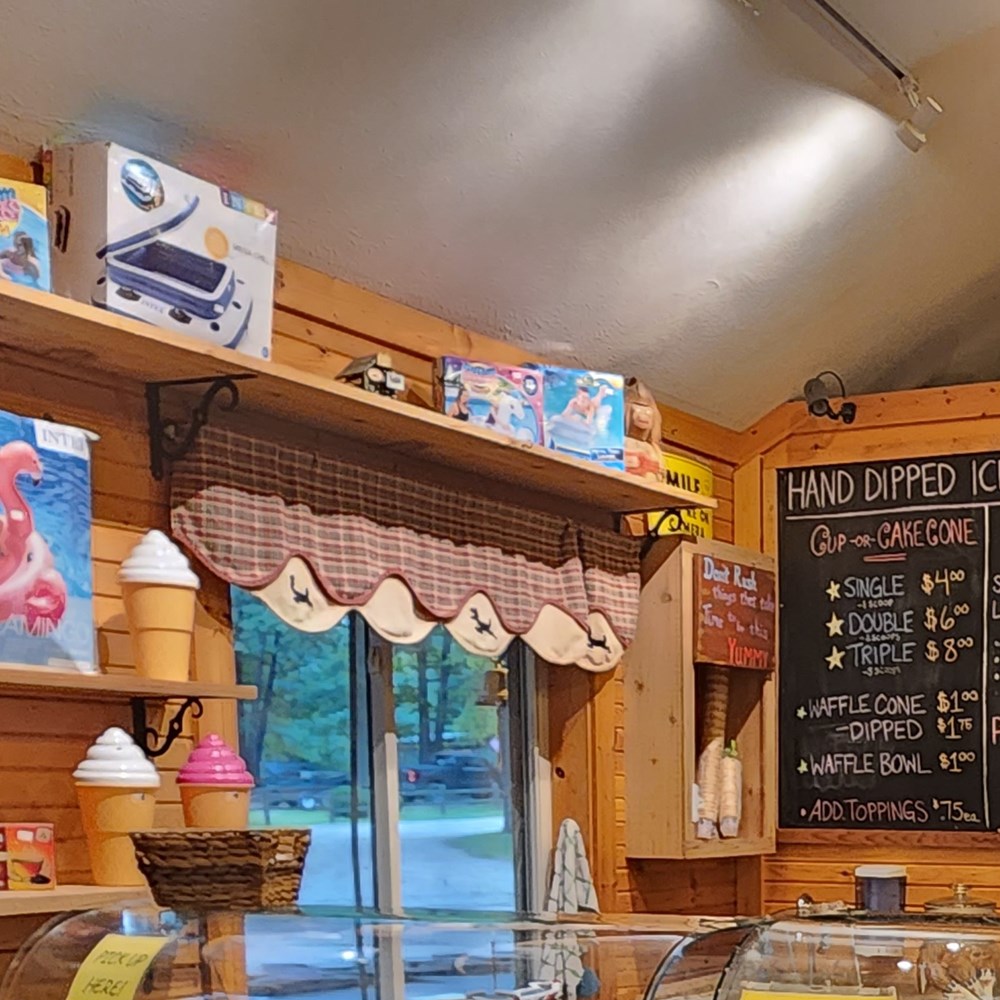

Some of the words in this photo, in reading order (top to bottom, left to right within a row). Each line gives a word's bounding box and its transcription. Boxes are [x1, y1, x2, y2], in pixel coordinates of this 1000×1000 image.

[788, 469, 854, 511] HAND
[864, 463, 956, 502] DIPPED
[877, 520, 924, 550] CAKE
[925, 517, 979, 546] CONE
[843, 574, 905, 599] SINGLE
[848, 609, 914, 635] DOUBLE
[846, 642, 917, 667] TRIPLE
[808, 694, 871, 719] WAFFLE
[874, 693, 927, 715] CONE
[810, 753, 875, 776] WAFFLE
[880, 752, 933, 776] BOWL
[845, 799, 928, 822] TOPPINGS
